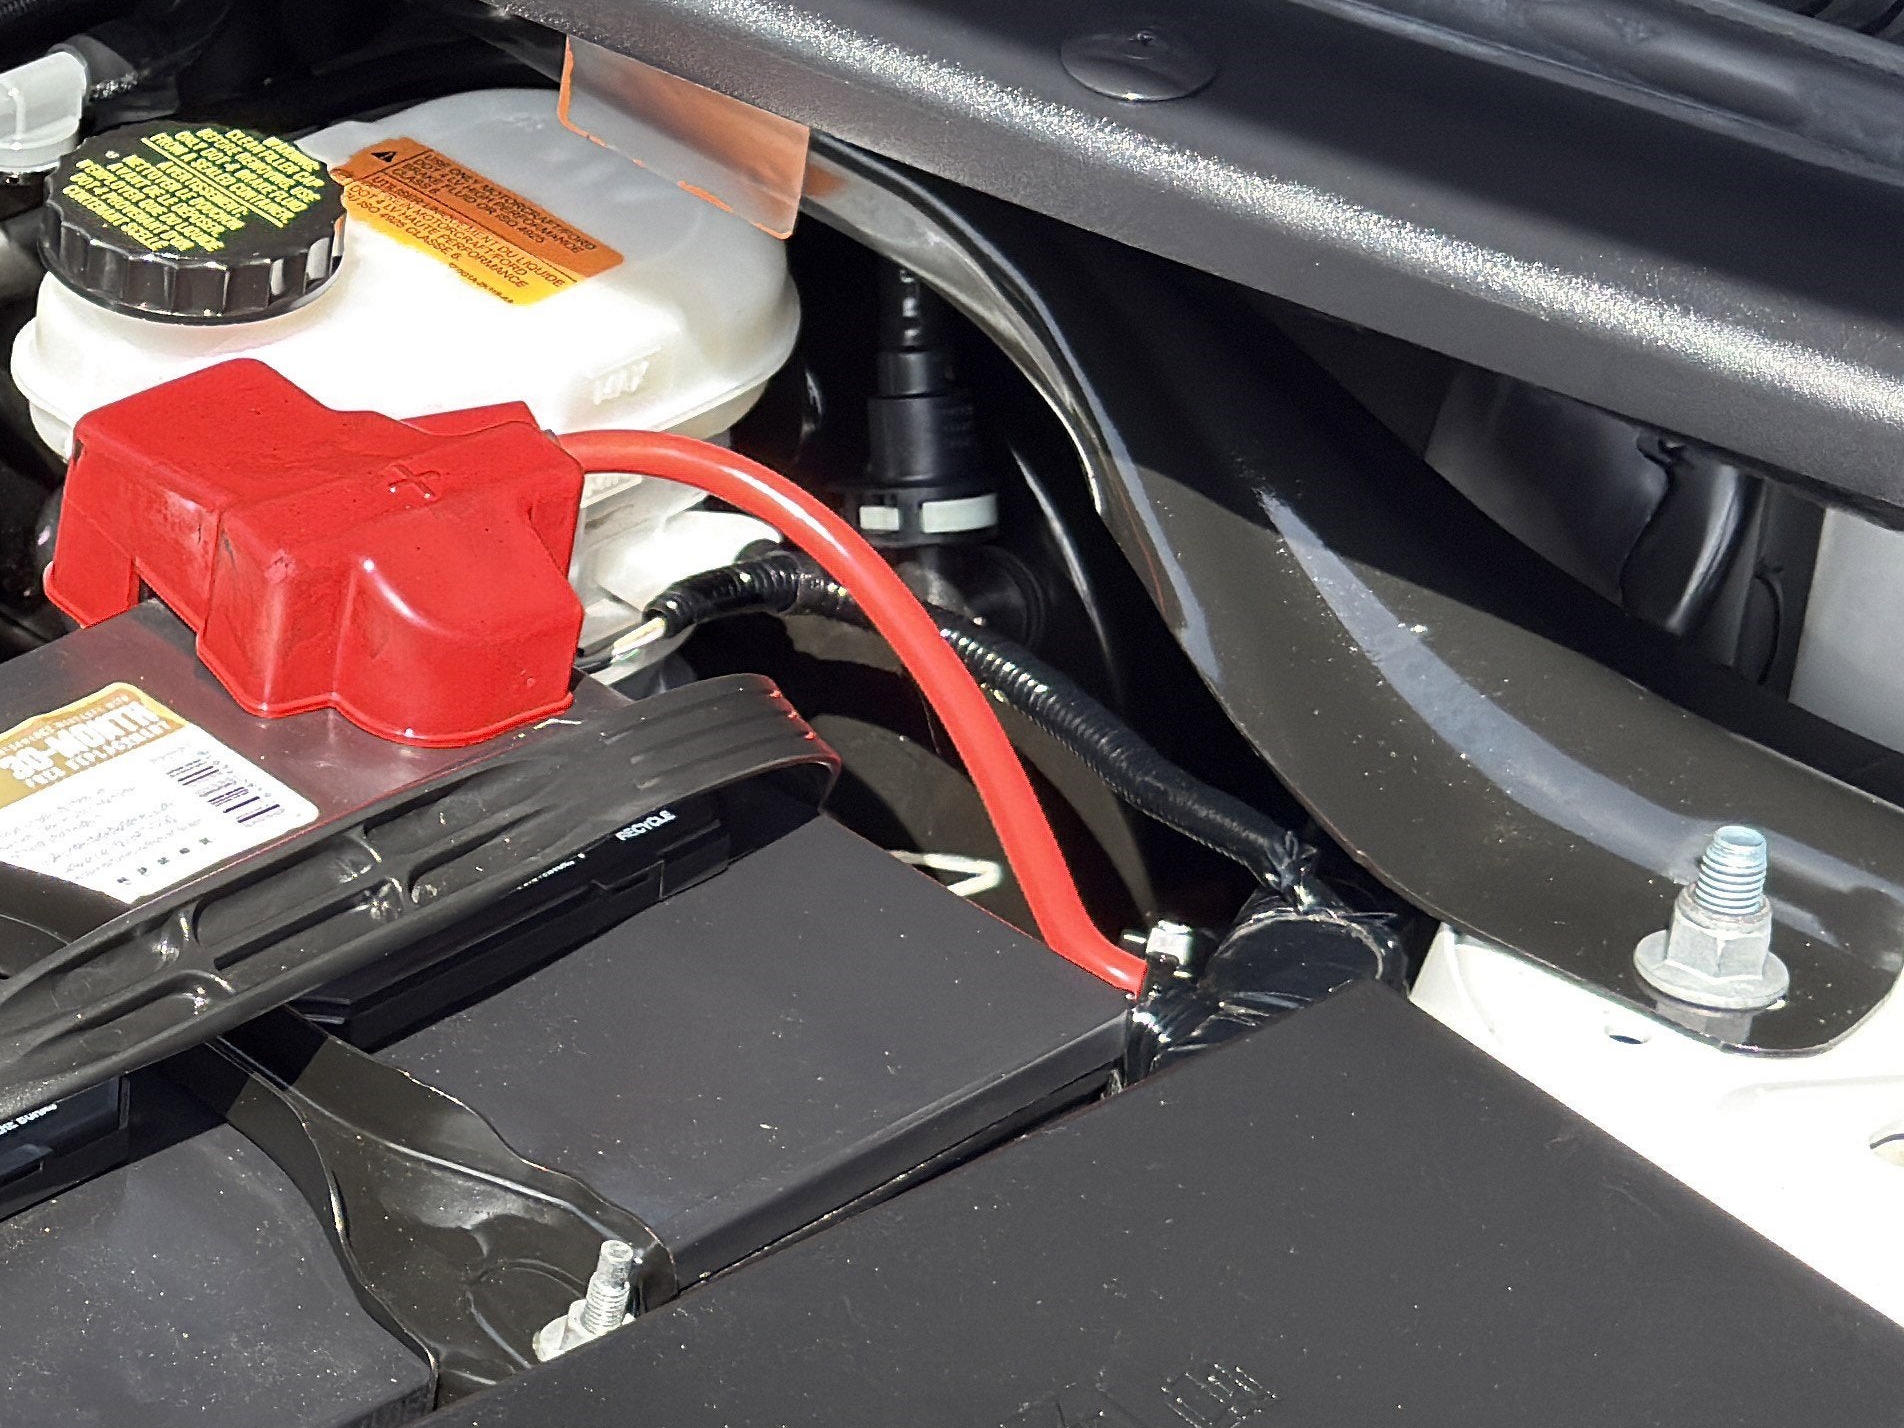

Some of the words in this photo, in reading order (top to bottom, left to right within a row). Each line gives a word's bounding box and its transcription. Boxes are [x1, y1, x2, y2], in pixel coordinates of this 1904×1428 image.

[112, 163, 151, 188] AVANT
[125, 156, 182, 192] NETTOYER
[152, 134, 191, 158] FROM
[192, 158, 236, 186] SEALED
[176, 133, 207, 150] ONLY
[202, 148, 231, 164] DOT
[235, 170, 278, 195] BRAKE
[270, 187, 308, 212] FLUID
[197, 130, 243, 156] BEFORE
[292, 188, 320, 203] USE
[227, 132, 266, 157] CLEAN
[257, 149, 300, 174] FILLER
[293, 171, 325, 188] CAP
[390, 167, 432, 190] CLASS
[412, 158, 442, 173] DOT
[461, 185, 494, 203] HIGH
[423, 153, 453, 169] USE
[71, 173, 101, 191] DOT
[400, 162, 443, 185] BRAKE
[439, 183, 478, 204] FLUID
[492, 213, 520, 227] ISO
[66, 185, 130, 226] CONTENANT
[356, 200, 382, 214] ISO
[402, 226, 455, 254] CLASSE
[347, 184, 378, 200] DOT
[398, 212, 440, 235] HAUTE
[433, 233, 532, 288] PERFORMANCE
[512, 256, 568, 287] LIQUIDE
[614, 809, 679, 841] RECYCLE
